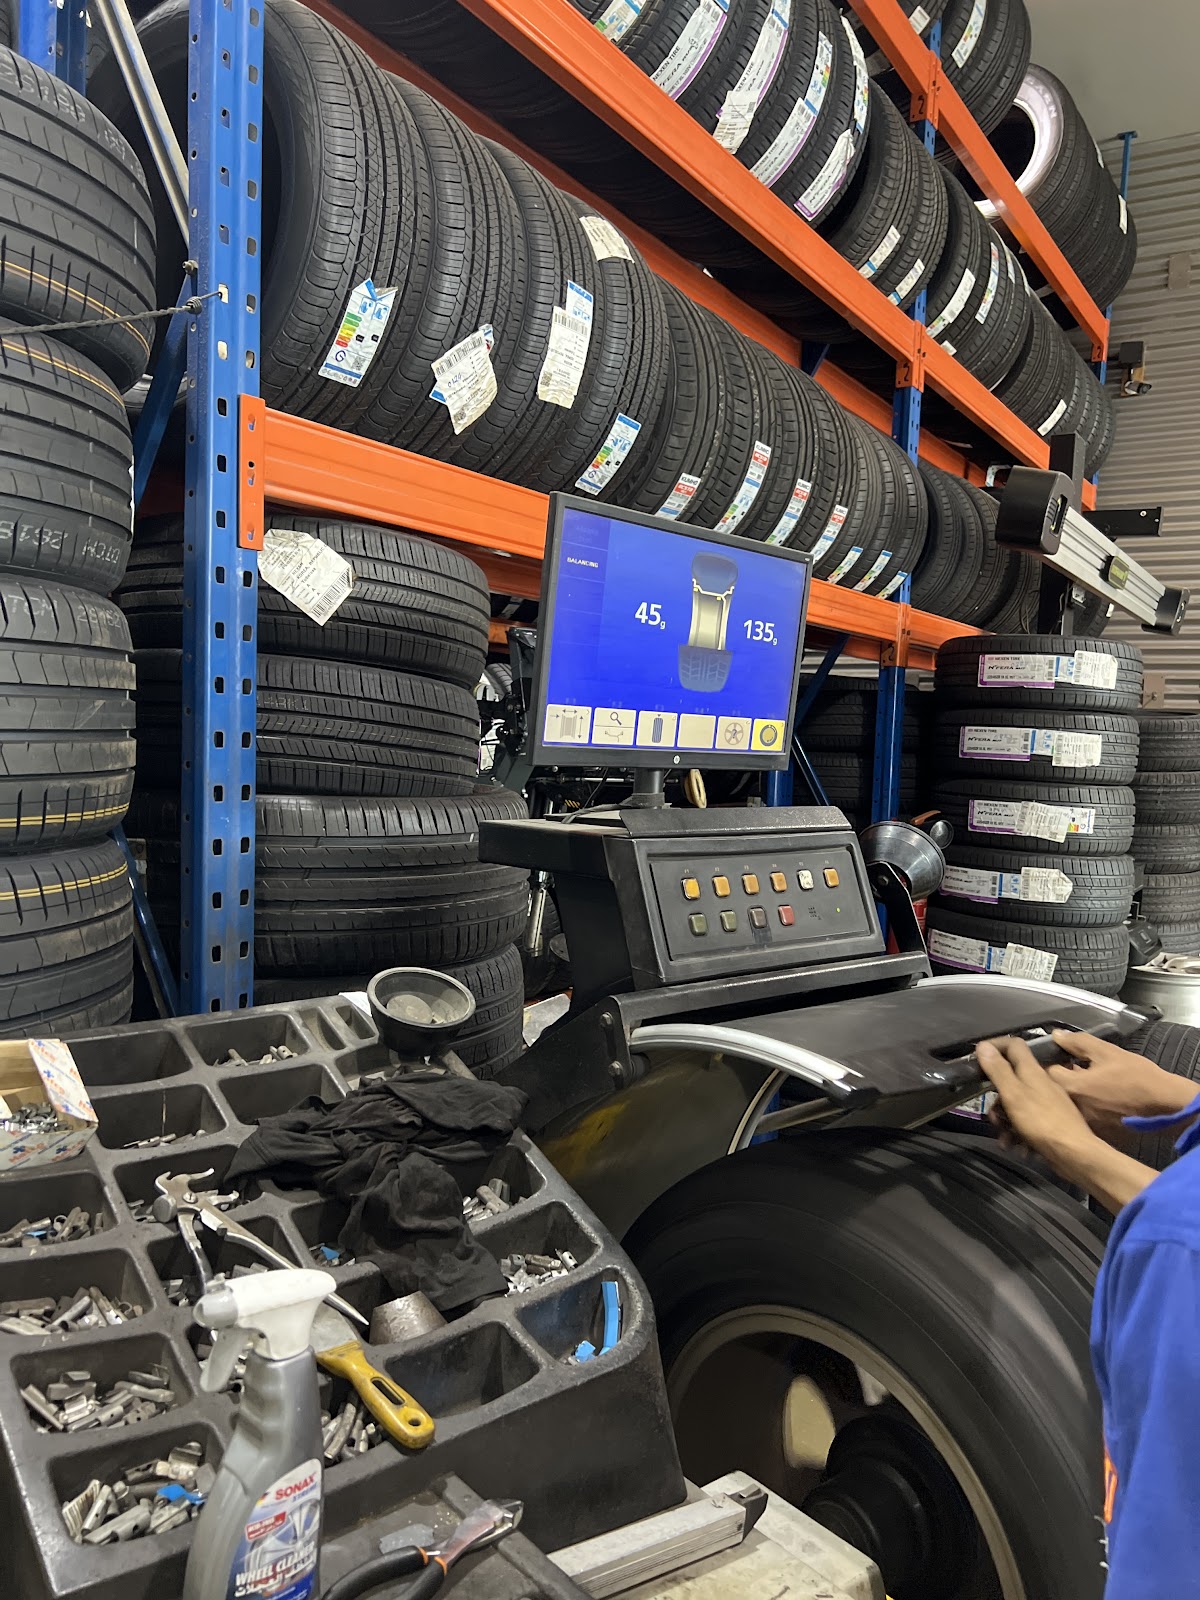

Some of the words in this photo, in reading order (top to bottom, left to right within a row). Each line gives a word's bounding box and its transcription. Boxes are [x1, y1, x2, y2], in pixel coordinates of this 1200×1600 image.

[652, 60, 670, 81] NEXEN
[668, 46, 681, 60] TIRE
[567, 556, 599, 568] BALANCING
[275, 1475, 315, 1500] SONAX
[235, 1564, 273, 1586] WHEEL
[276, 1541, 315, 1571] CLEANER
